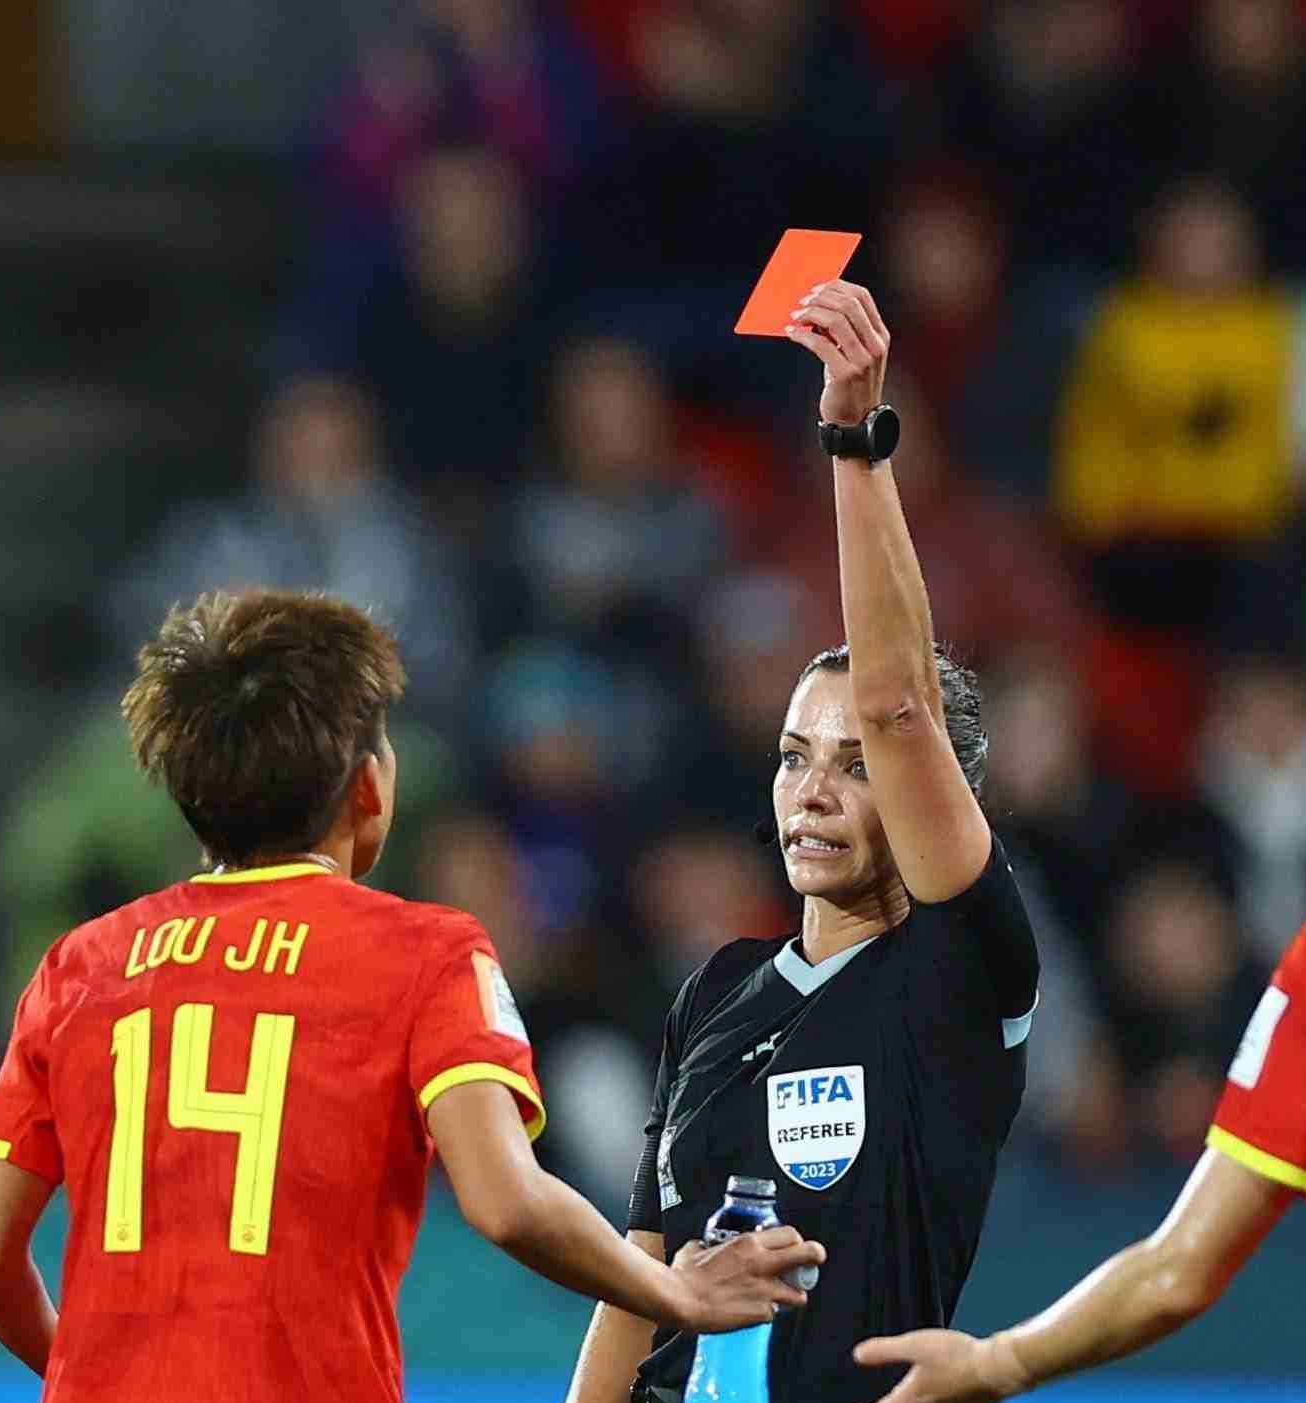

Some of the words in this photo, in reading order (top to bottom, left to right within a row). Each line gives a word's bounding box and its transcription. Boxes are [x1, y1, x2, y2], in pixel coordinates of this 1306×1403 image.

[124, 916, 217, 979] LOU
[224, 918, 309, 975] JH
[776, 1074, 854, 1110] FIFA
[103, 1002, 296, 1256] 14
[777, 1121, 857, 1144] REFEREE
[799, 1162, 837, 1180] 2023
